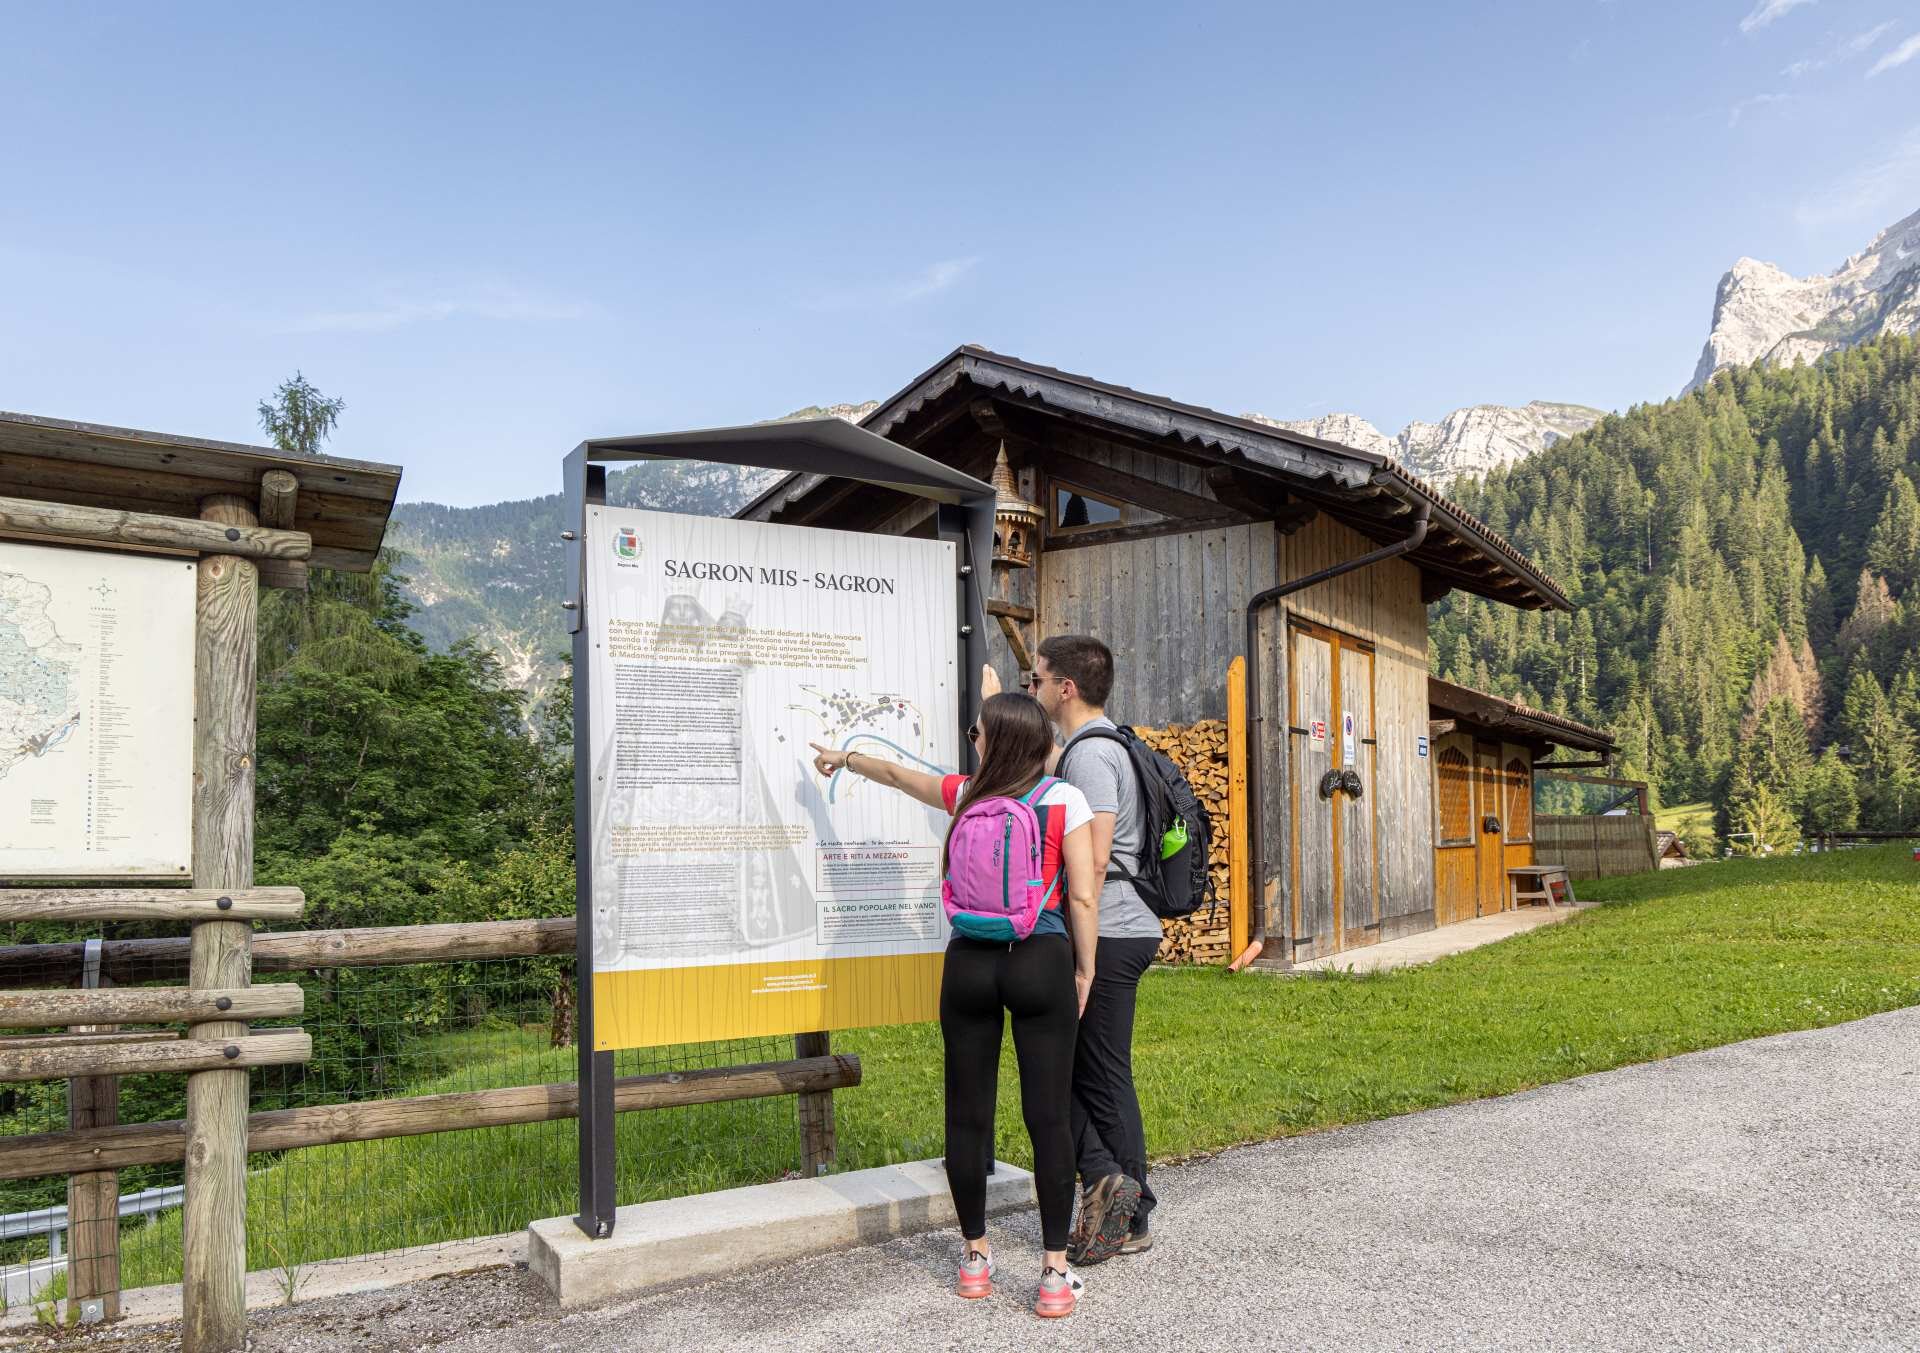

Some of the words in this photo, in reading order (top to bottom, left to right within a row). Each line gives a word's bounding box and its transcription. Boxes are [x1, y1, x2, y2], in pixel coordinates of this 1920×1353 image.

[664, 559, 754, 583] SAGRON
[760, 568, 797, 587] MIS
[814, 572, 895, 594] SAGRON
[617, 620, 644, 628] Sagron
[777, 630, 804, 638] dedicati
[609, 636, 640, 644] secondo
[747, 636, 782, 644] devozione
[609, 644, 642, 652] specifica
[650, 646, 688, 654] localizzata
[779, 653, 809, 661] spiegano
[619, 652, 656, 660] Madonne,
[784, 661, 814, 669] cappella,
[832, 905, 857, 913] SACRO
[859, 904, 897, 912] POPOLARE
